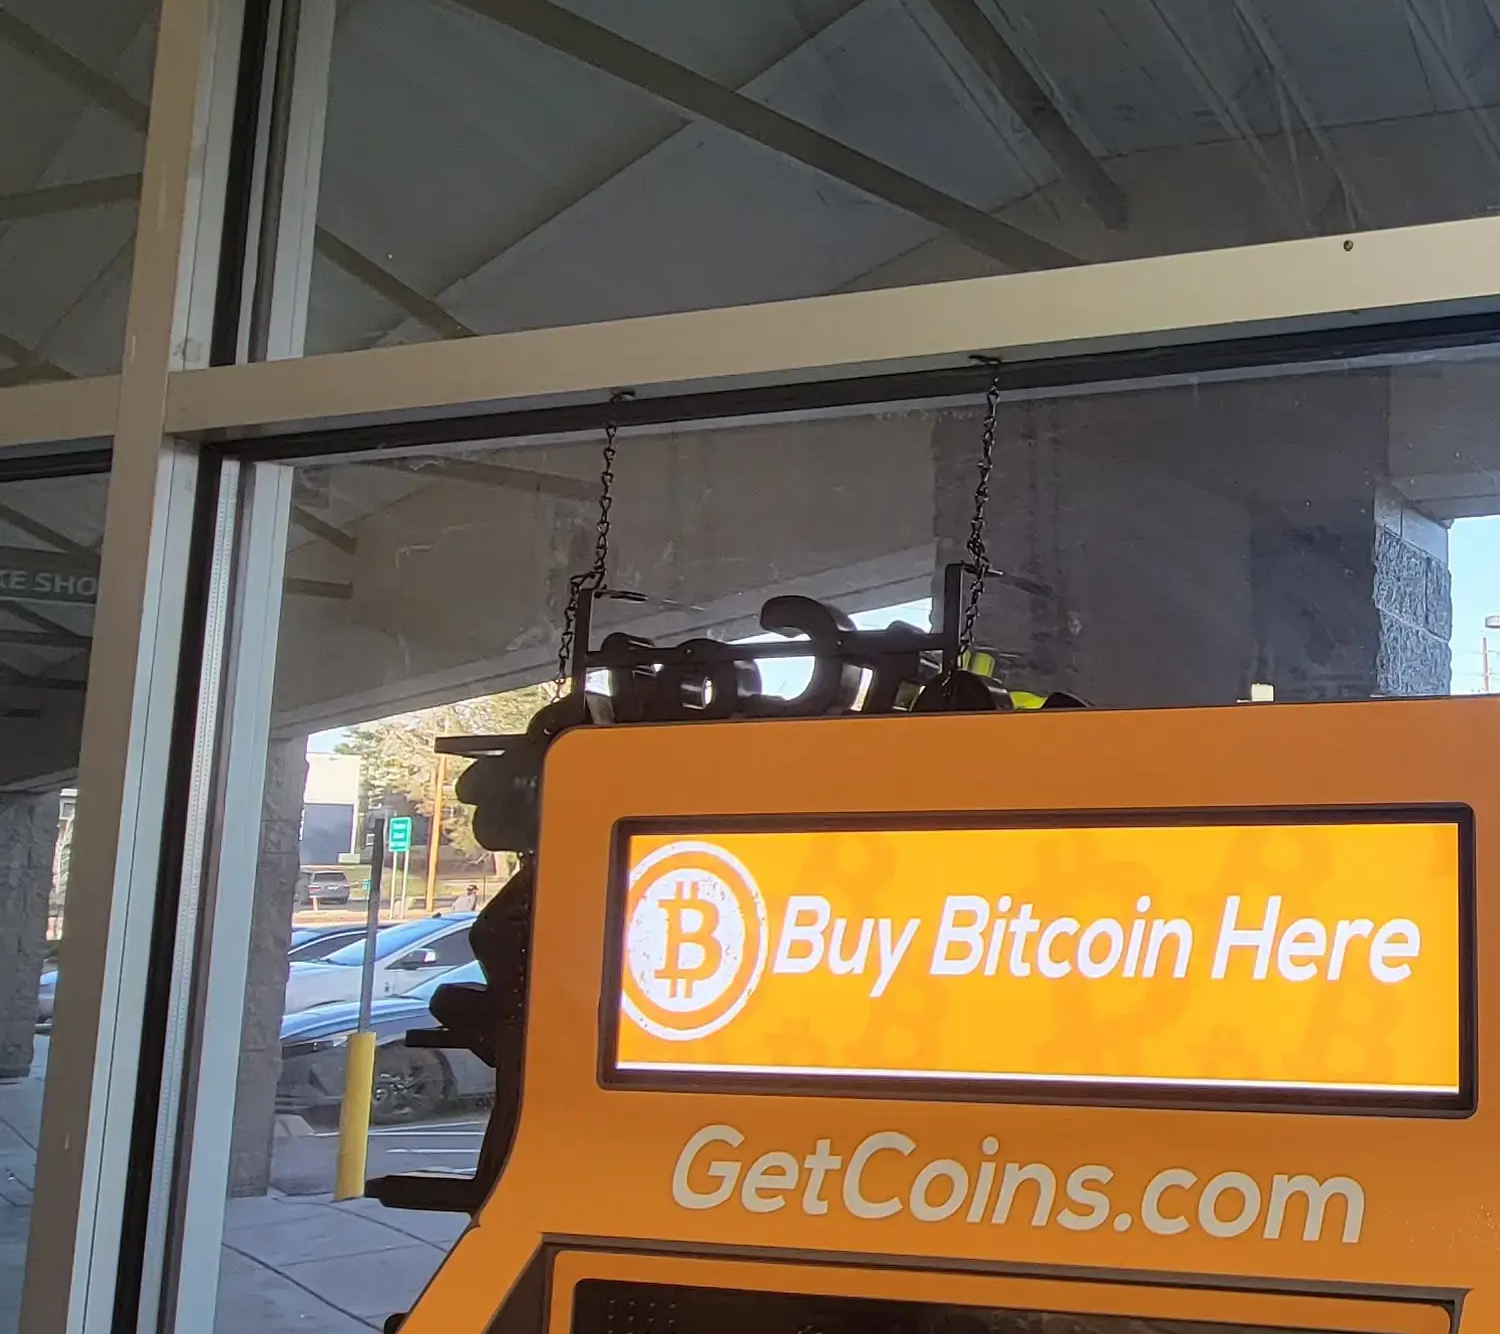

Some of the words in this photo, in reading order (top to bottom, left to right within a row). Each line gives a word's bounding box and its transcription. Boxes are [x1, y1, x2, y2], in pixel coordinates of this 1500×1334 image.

[773, 895, 919, 997] Buy
[929, 894, 1193, 980] Bitcoin
[1210, 894, 1421, 984] Here
[672, 1123, 1365, 1244] GetCoins.com
